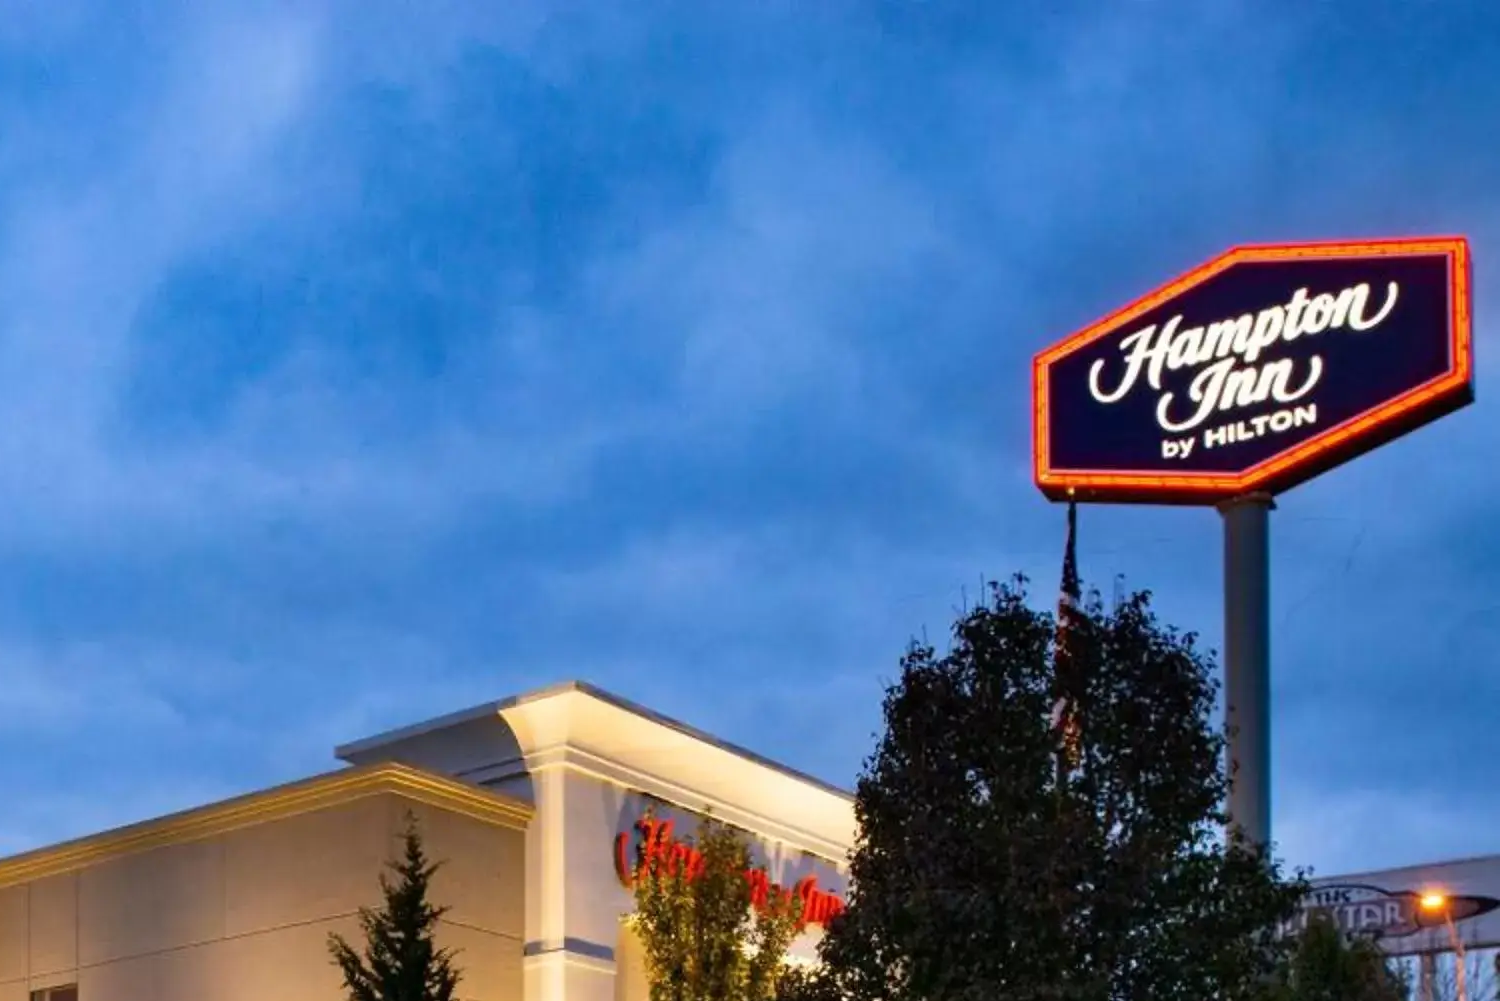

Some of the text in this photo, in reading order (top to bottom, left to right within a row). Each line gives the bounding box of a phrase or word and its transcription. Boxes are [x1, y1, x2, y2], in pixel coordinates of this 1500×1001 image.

[1088, 281, 1399, 403] Hampton
[1156, 355, 1323, 432] Inn
[1161, 403, 1317, 459] by HILTON
